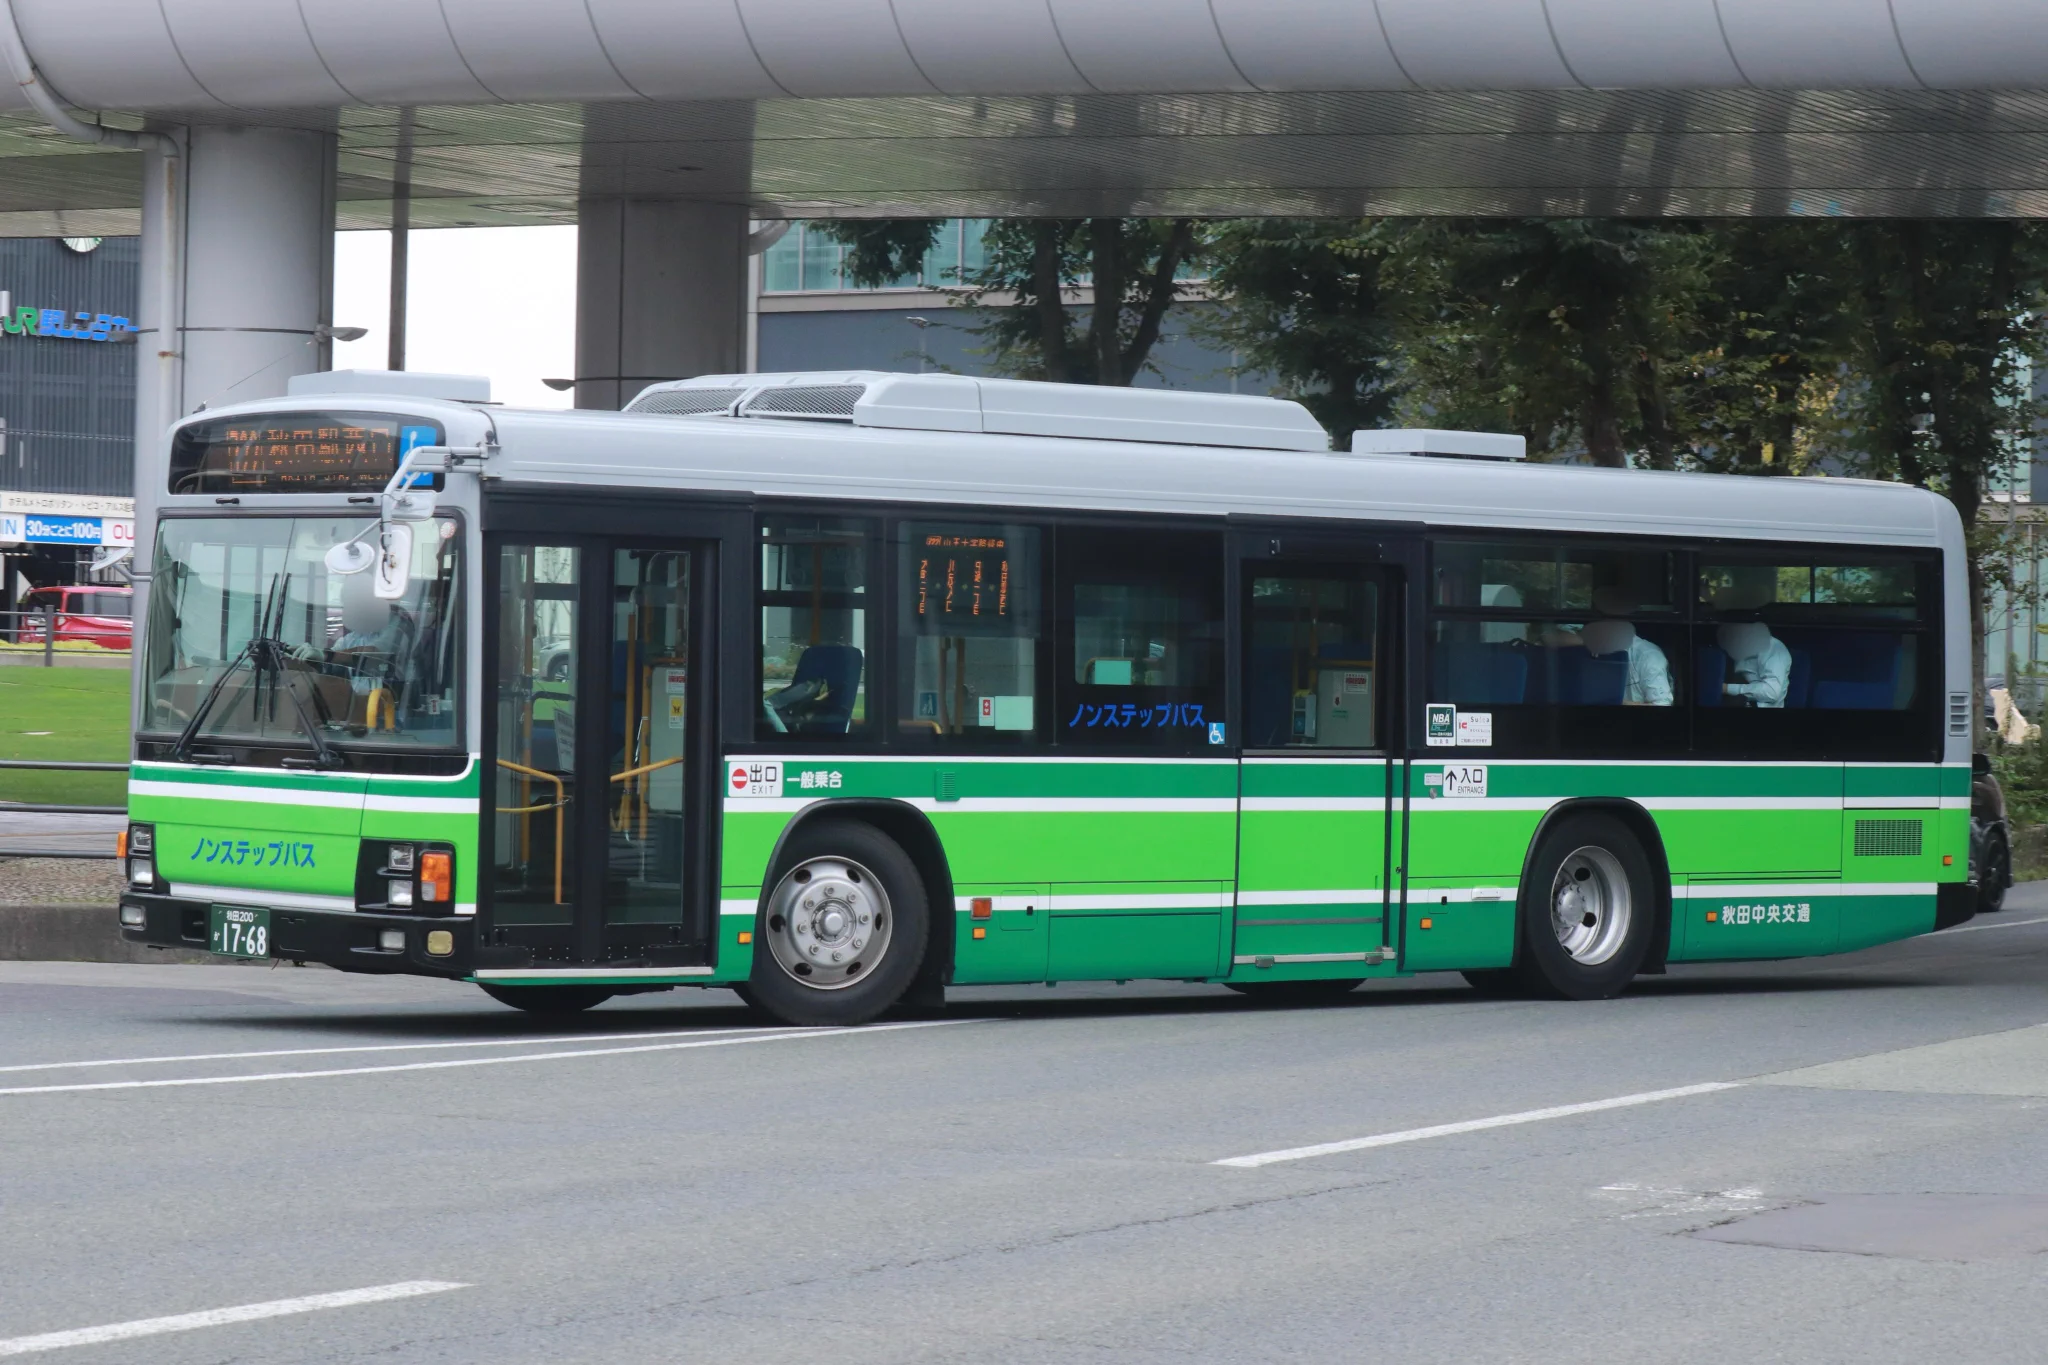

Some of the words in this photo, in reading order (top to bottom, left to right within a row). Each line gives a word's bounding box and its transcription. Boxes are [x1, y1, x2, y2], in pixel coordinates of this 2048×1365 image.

[113, 524, 135, 540] OU
[1069, 703, 1206, 728] ノンステップバス
[1432, 713, 1450, 723] NBA
[750, 764, 777, 783] 出口
[786, 771, 843, 789] 一般乗合
[1460, 767, 1483, 784] 入口
[752, 785, 774, 795] EXIT
[1457, 785, 1485, 794] ENTRANCE
[191, 838, 316, 868] ノンステップバス
[1722, 903, 1811, 925] 秋田中央交通
